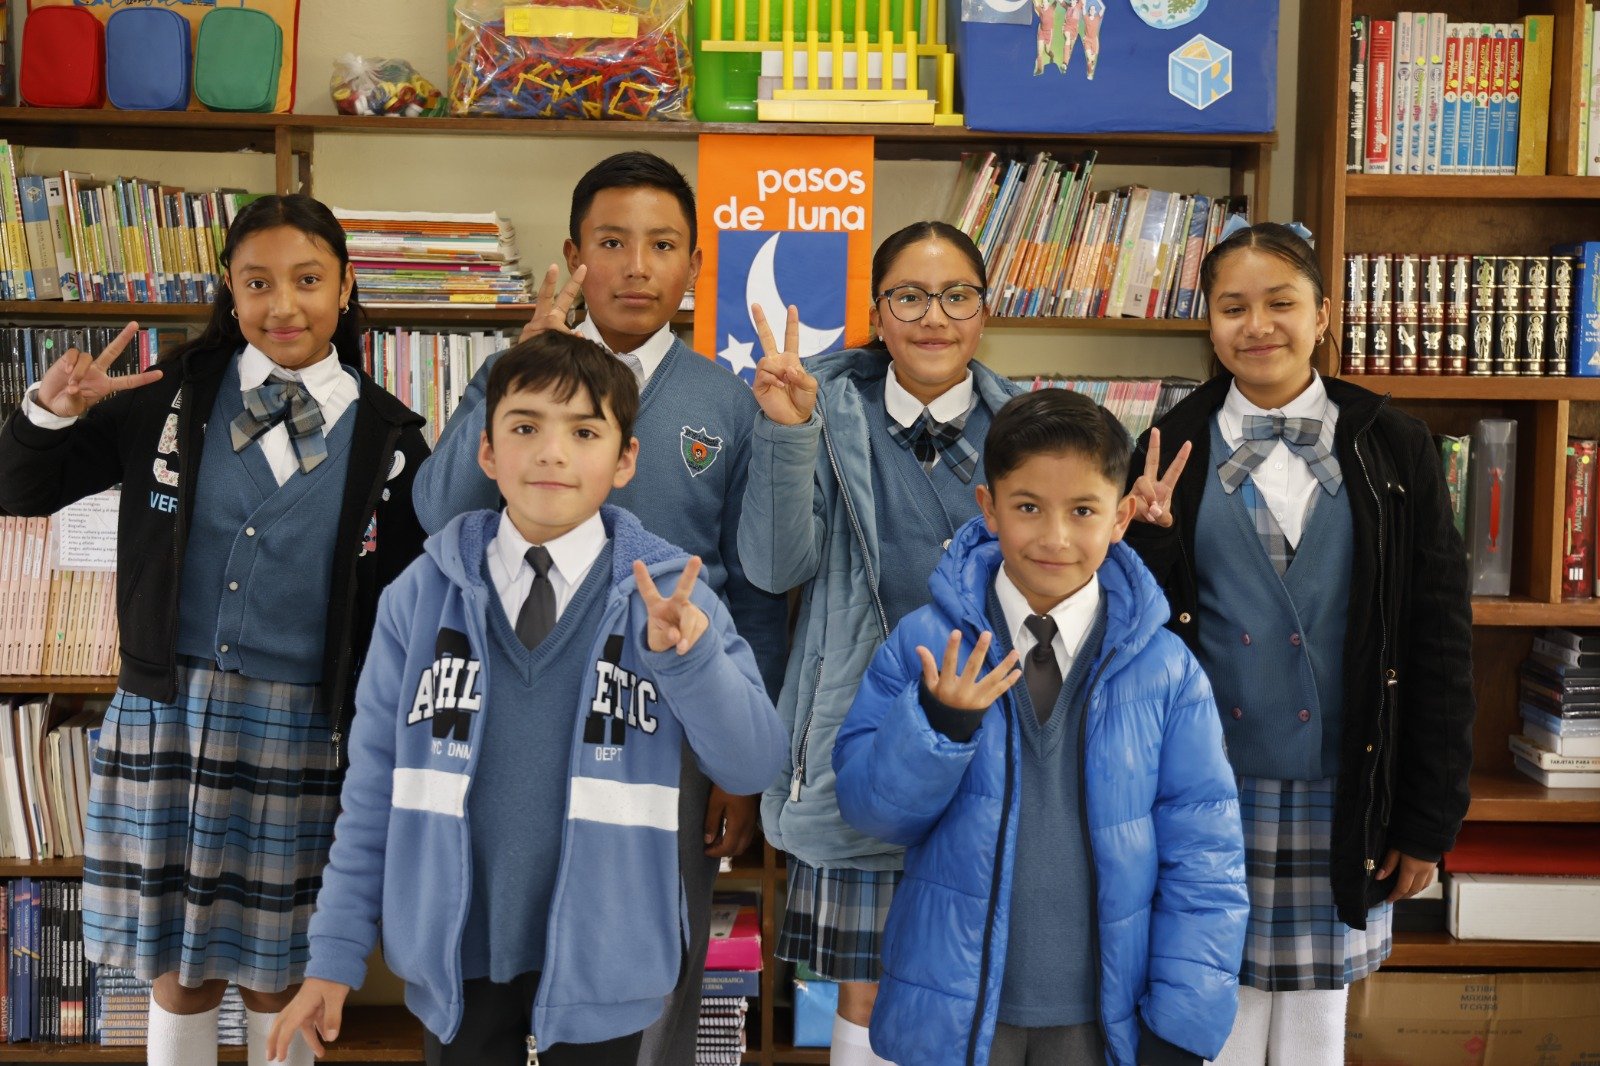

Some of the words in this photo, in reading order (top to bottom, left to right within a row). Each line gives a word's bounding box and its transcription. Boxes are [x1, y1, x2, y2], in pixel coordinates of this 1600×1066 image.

[757, 167, 865, 201] pasos
[713, 196, 764, 230] de
[788, 197, 864, 230] luna
[592, 660, 657, 734] ETIC
[595, 747, 622, 761] DEPT
